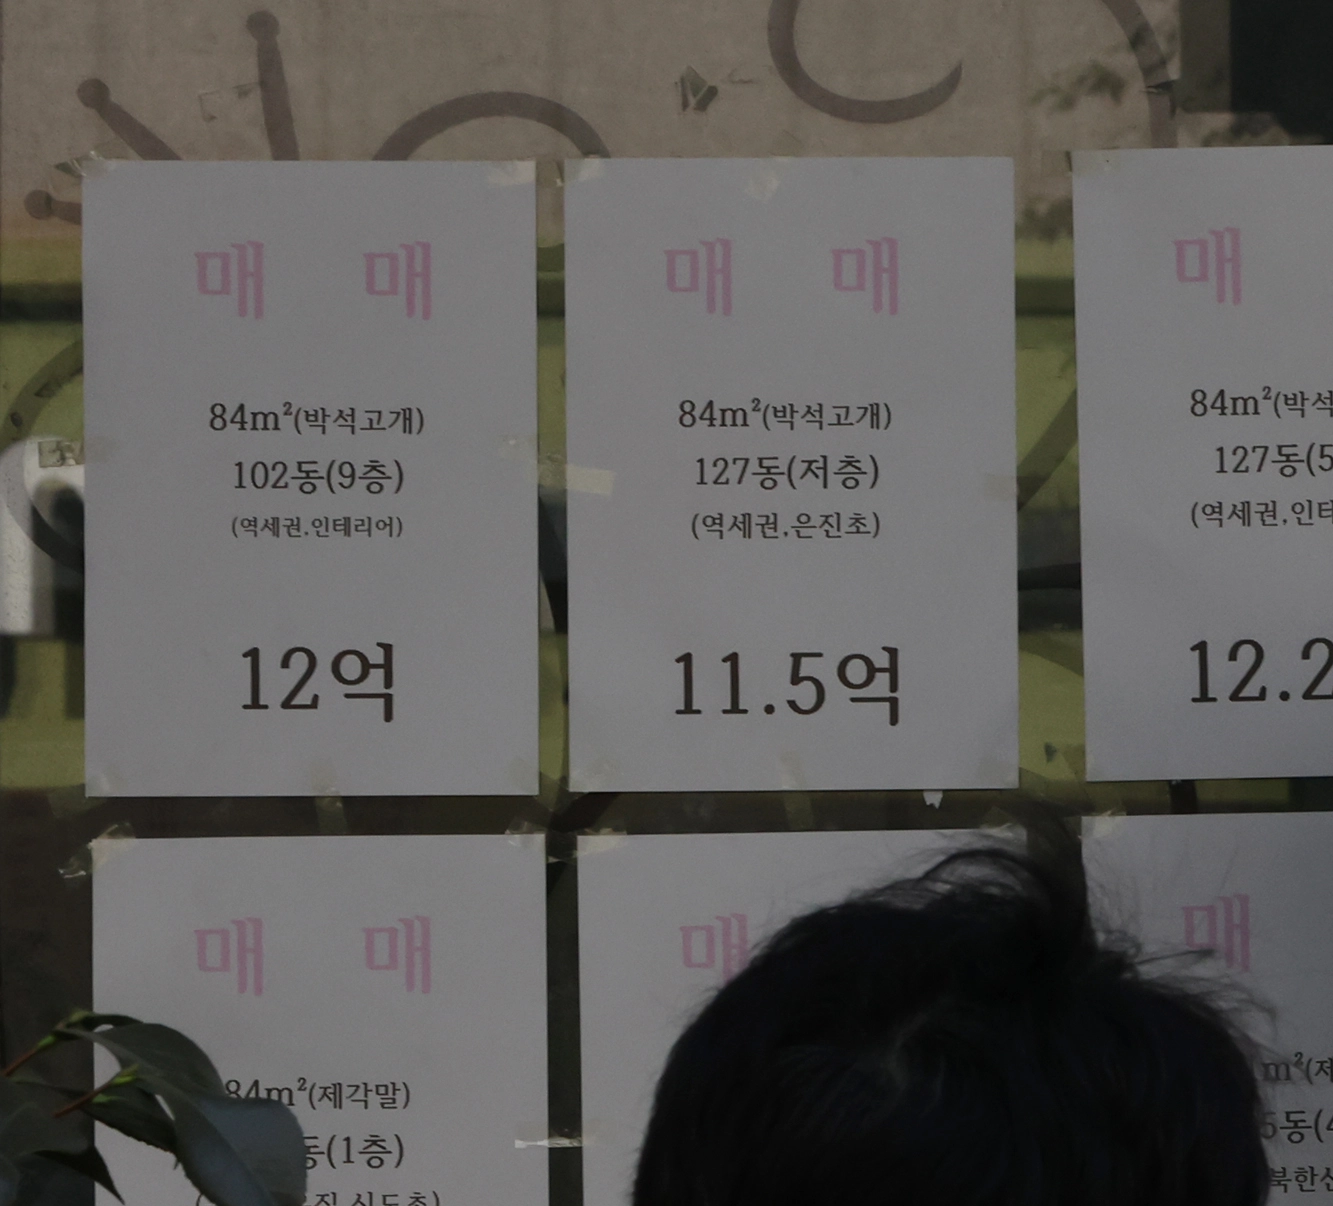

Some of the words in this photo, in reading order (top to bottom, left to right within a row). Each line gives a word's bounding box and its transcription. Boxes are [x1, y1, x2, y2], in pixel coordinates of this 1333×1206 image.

[194, 239, 265, 321] 매
[363, 240, 433, 321] 매
[664, 237, 734, 317] 매
[830, 236, 900, 316] 매
[1173, 226, 1244, 306] 매
[234, 459, 405, 496] 102동(9층)
[695, 454, 880, 491] 127동(저층)
[241, 641, 395, 724] 12억
[674, 645, 900, 727] 11.5억
[193, 916, 265, 997] 매
[363, 915, 433, 995] 매
[680, 913, 749, 985] 매
[1182, 893, 1250, 973] 매
[303, 1134, 404, 1169] 동(1층)
